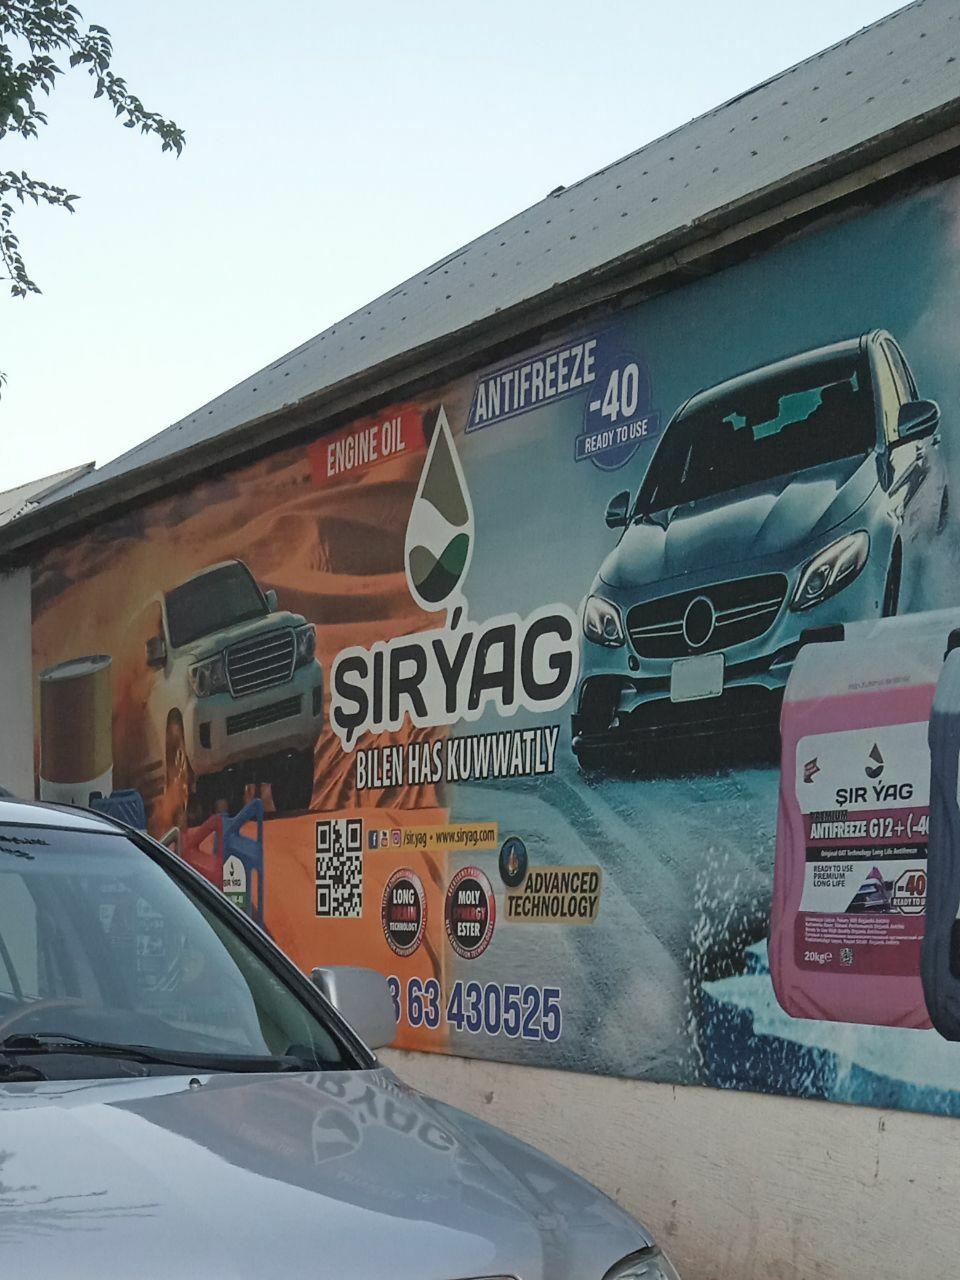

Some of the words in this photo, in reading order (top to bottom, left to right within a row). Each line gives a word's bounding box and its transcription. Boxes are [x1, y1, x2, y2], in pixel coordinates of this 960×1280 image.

[474, 339, 597, 423] ANTIFREEZE
[589, 362, 640, 422] -40
[585, 432, 613, 452] READY
[615, 427, 629, 444] TO
[629, 419, 648, 440] USE
[327, 423, 379, 478] ENGINE
[381, 416, 406, 455] OIL
[356, 746, 404, 790] BILEN
[408, 741, 442, 784] HAS
[447, 725, 560, 782] KUWWATLY
[835, 787, 867, 807] ŞIR
[873, 780, 913, 802] ÝAG
[436, 828, 495, 846] www.siryag.com
[810, 820, 867, 839] ANTIFREEZE
[842, 864, 853, 872] USE
[524, 872, 599, 894] ADVANCED
[393, 889, 415, 904] LONG
[458, 890, 481, 905] MOLY
[508, 895, 598, 918] TECHNOLOGY
[389, 922, 417, 932] TECHNOLOGY
[457, 922, 481, 937] ESTER
[407, 976, 440, 1029] 63
[447, 980, 562, 1042] 430525
